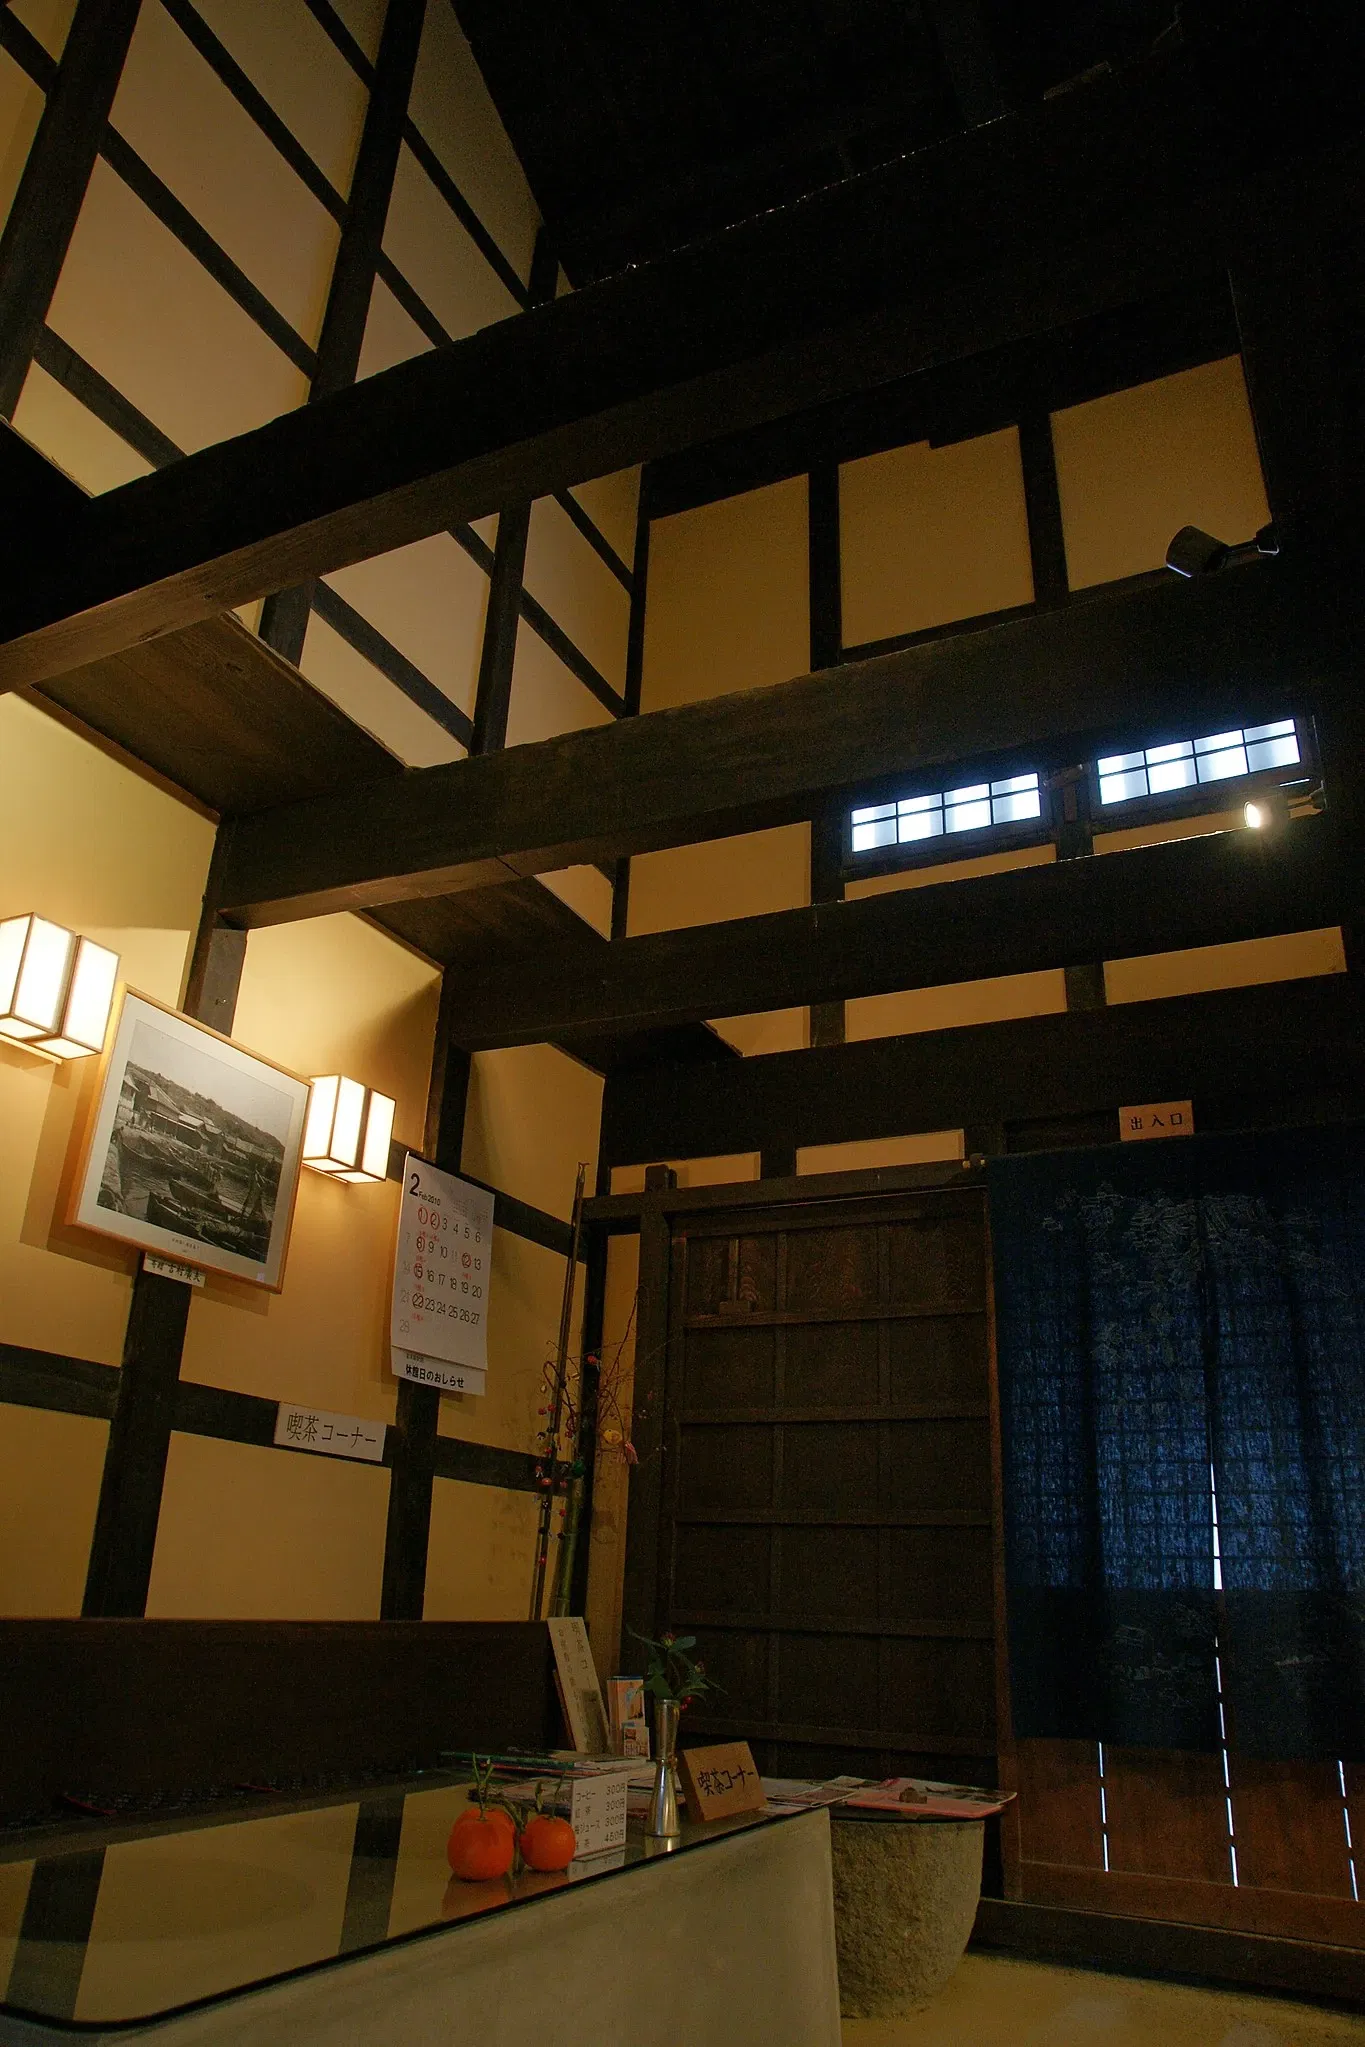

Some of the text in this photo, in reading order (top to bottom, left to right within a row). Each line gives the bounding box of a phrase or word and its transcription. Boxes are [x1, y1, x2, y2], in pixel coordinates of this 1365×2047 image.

[1130, 1112, 1182, 1131] 出入口
[409, 1172, 420, 1197] 2
[442, 1217, 448, 1230] 3
[453, 1223, 459, 1235] 4
[464, 1227, 470, 1239] 5
[475, 1231, 481, 1243] 6
[416, 1236, 423, 1249] 8
[428, 1240, 435, 1253] 9
[440, 1245, 448, 1259] 10
[474, 1257, 481, 1271] 13
[426, 1269, 435, 1283] 16
[438, 1273, 446, 1285] 17
[449, 1277, 457, 1290] 18
[461, 1281, 469, 1294] 19
[471, 1284, 482, 1299] 20
[412, 1293, 424, 1309] 22
[424, 1297, 436, 1312] 23
[436, 1301, 446, 1314] 24
[448, 1304, 458, 1319] 25
[459, 1308, 470, 1323] 26
[470, 1312, 480, 1325] 27
[405, 1363, 465, 1388] 休館日のおしらせ
[286, 1411, 377, 1449] 喫茶コーナー
[605, 1782, 626, 1796] 300円
[697, 1764, 754, 1797] 喫茶コーナー
[605, 1798, 625, 1811] 300円
[604, 1813, 625, 1827] 300円
